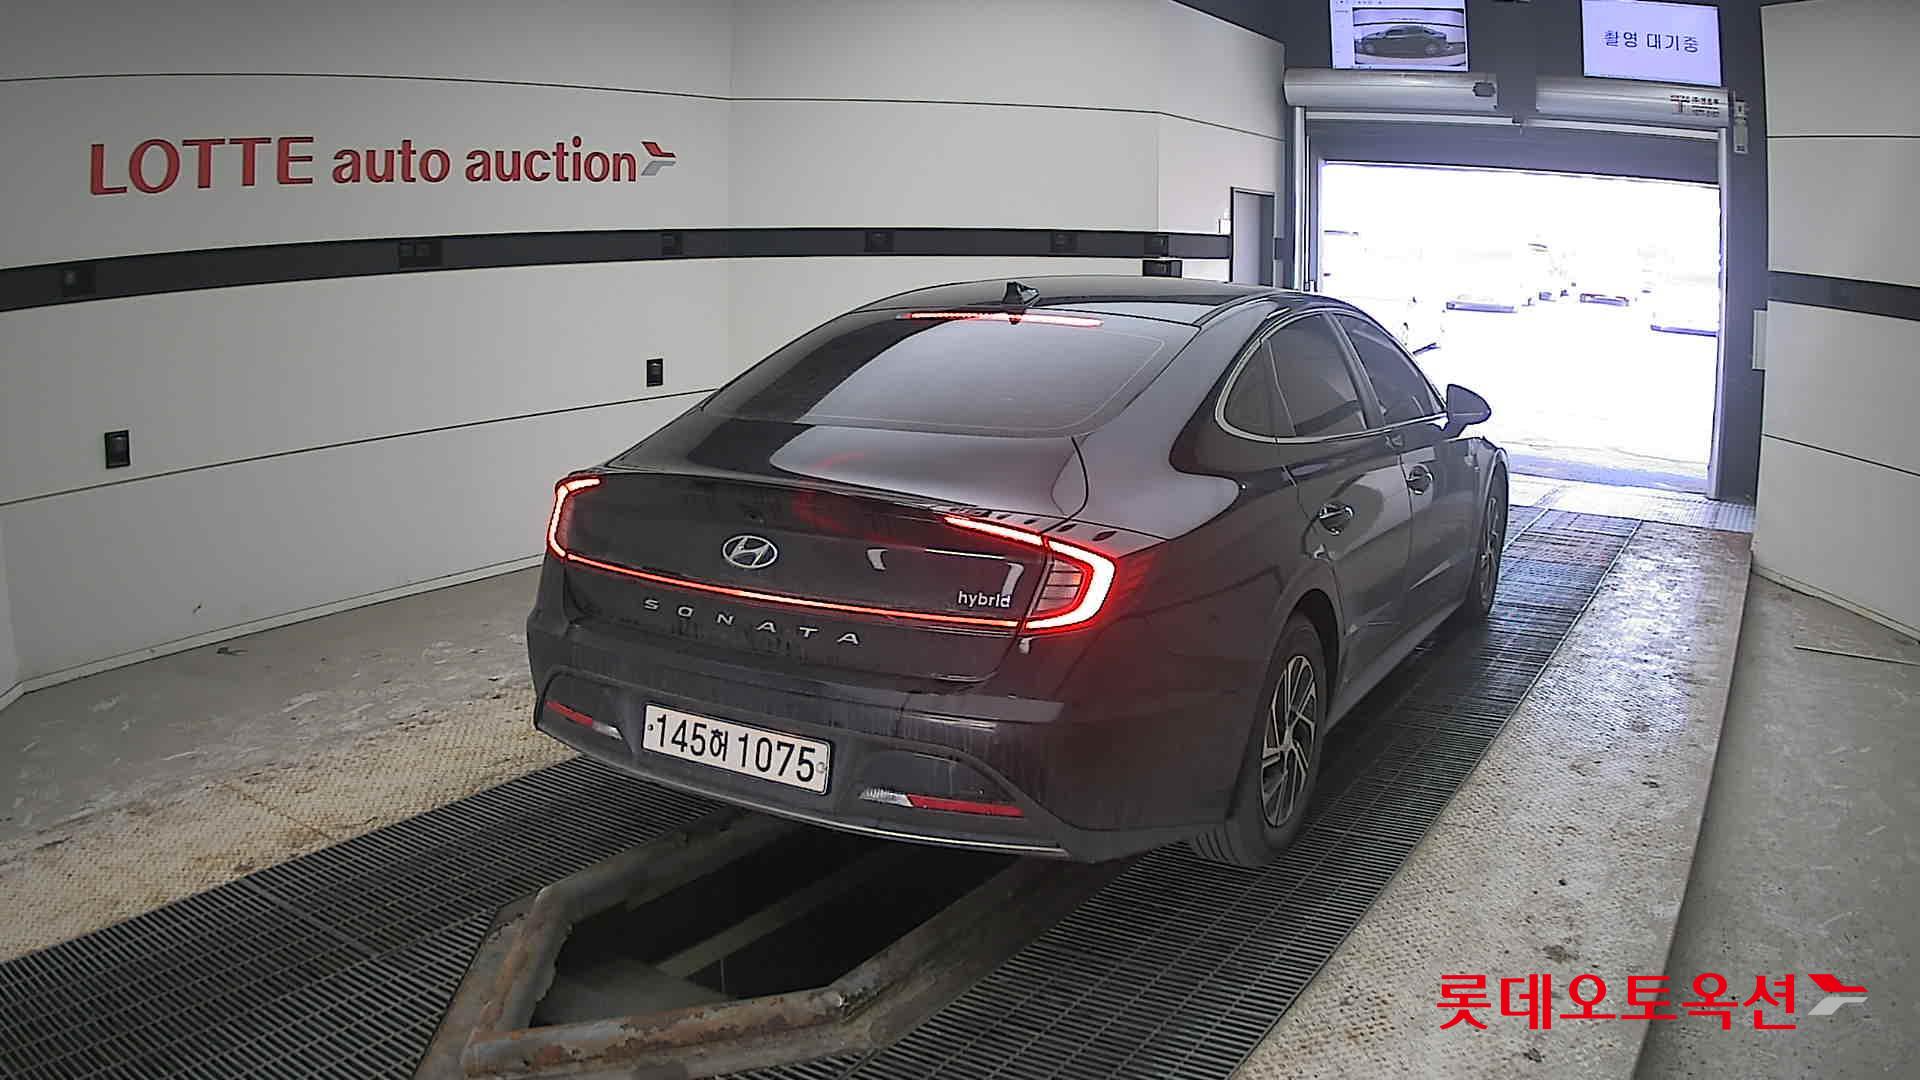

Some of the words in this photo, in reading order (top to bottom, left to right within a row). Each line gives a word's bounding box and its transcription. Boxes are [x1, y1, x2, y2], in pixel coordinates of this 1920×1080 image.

[1605, 30, 1637, 48] 촬영
[1646, 33, 1698, 53] 대기중
[90, 136, 315, 195] LOTTE
[332, 139, 451, 184] auto
[464, 136, 637, 183] auction
[957, 590, 1011, 609] hybrid
[643, 598, 860, 645] SONATA
